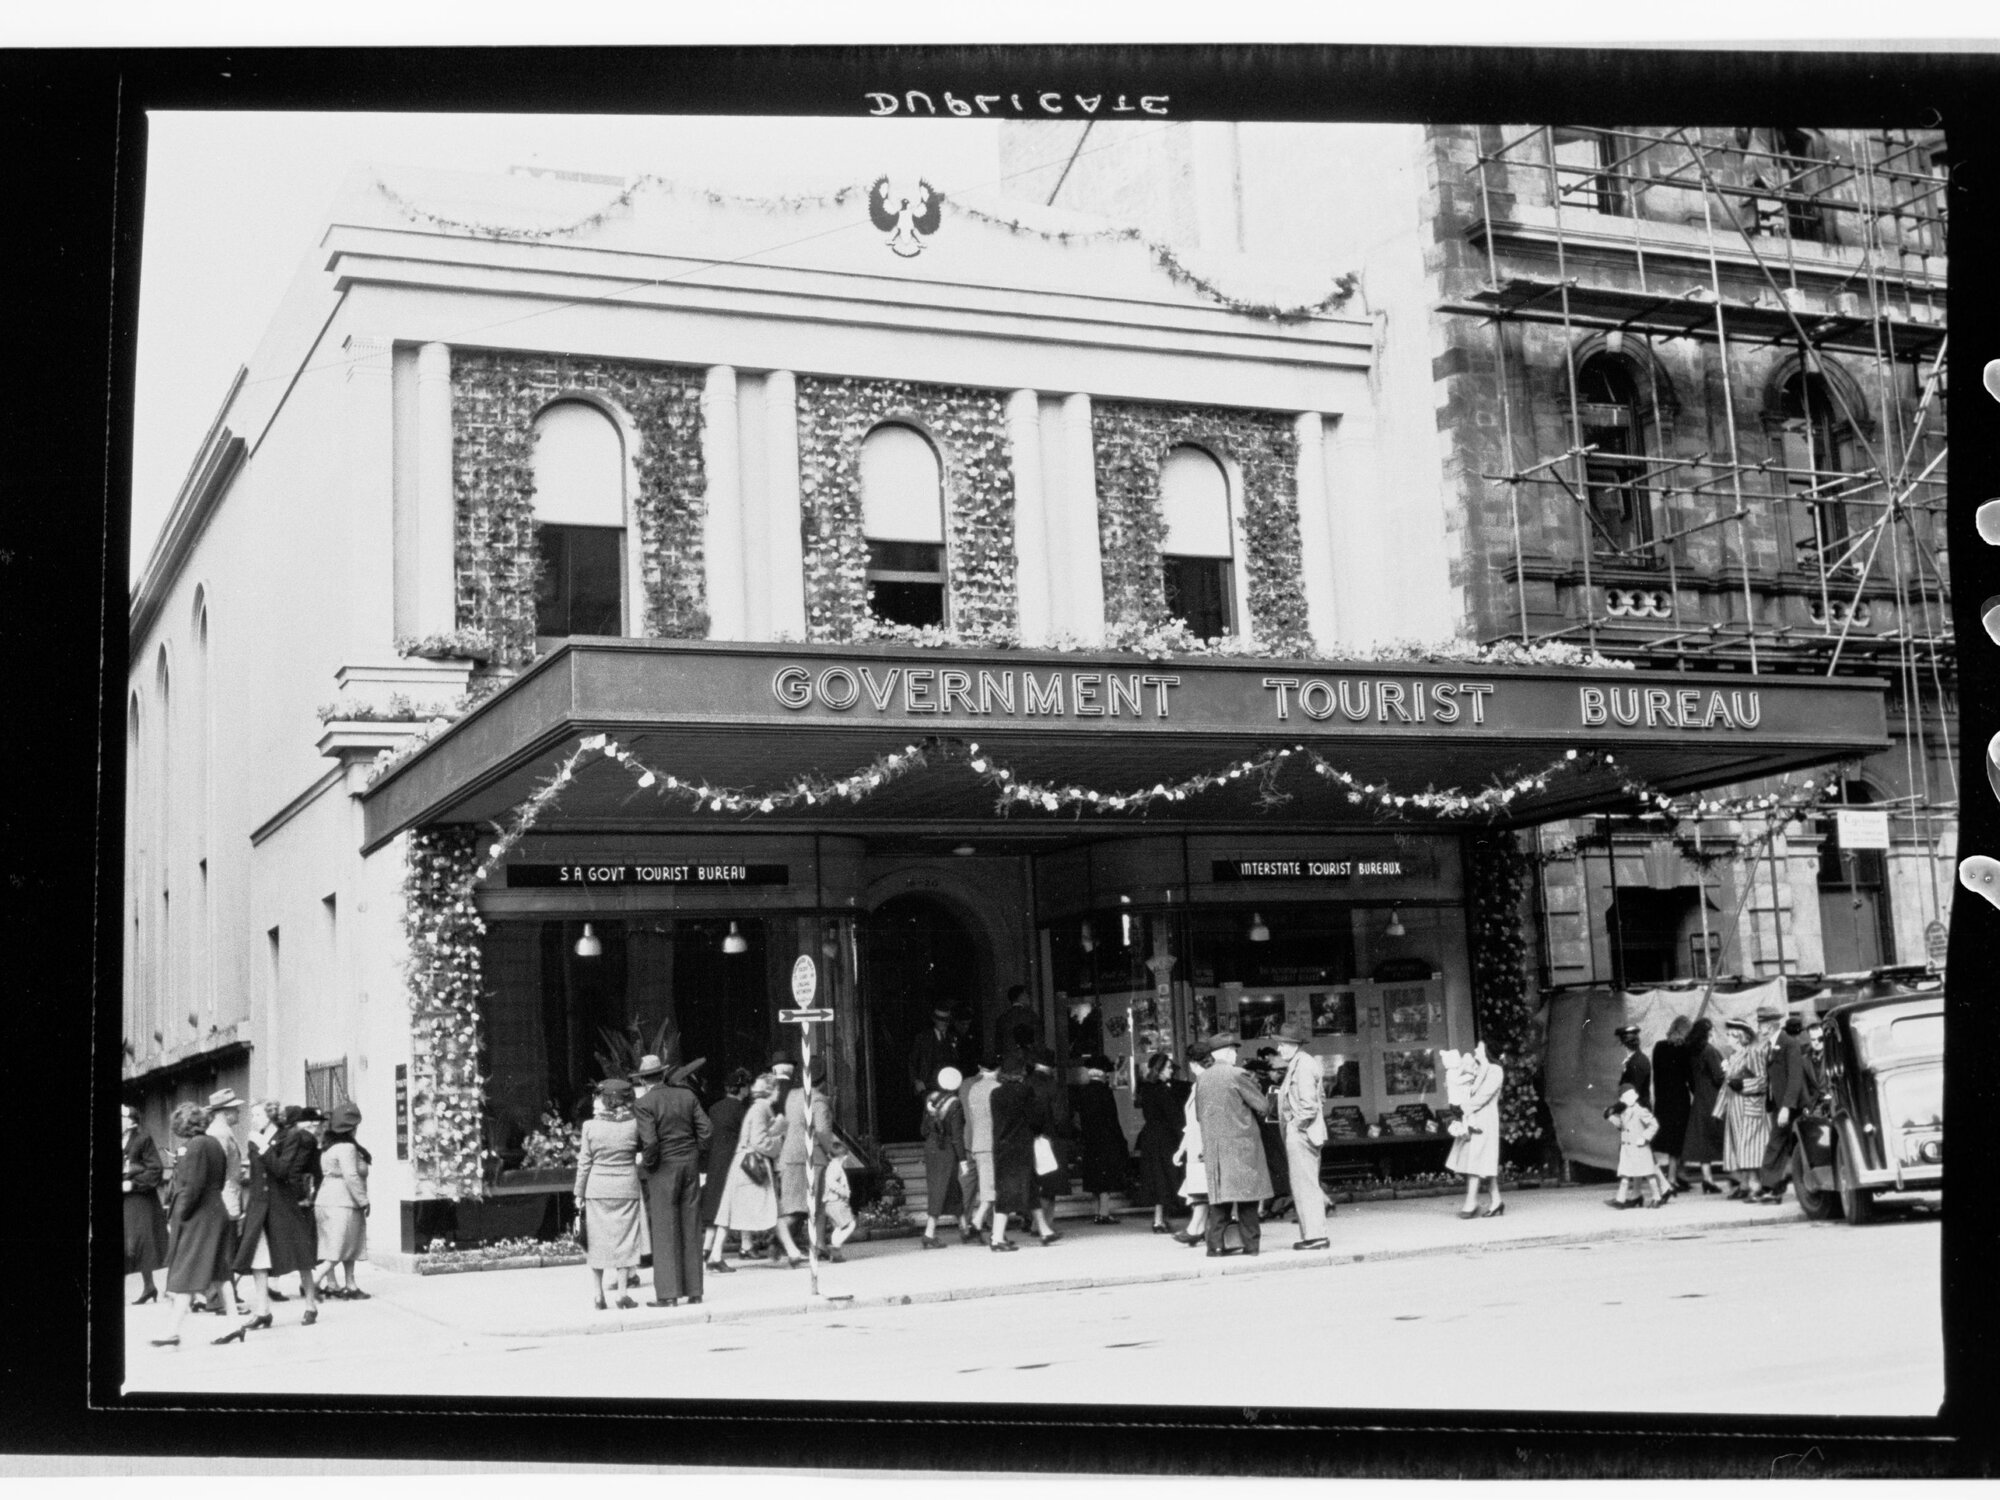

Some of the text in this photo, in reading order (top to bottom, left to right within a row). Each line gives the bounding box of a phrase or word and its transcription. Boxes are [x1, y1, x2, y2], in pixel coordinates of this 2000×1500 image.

[772, 665, 1761, 729] GOVERNMENT TOURIST BUREAU
[588, 866, 626, 882] GOVT
[635, 865, 689, 881] TOURIST
[698, 864, 746, 881] BUREAU
[1240, 861, 1402, 876] INTERSTATE TOURIST BUREAUX
